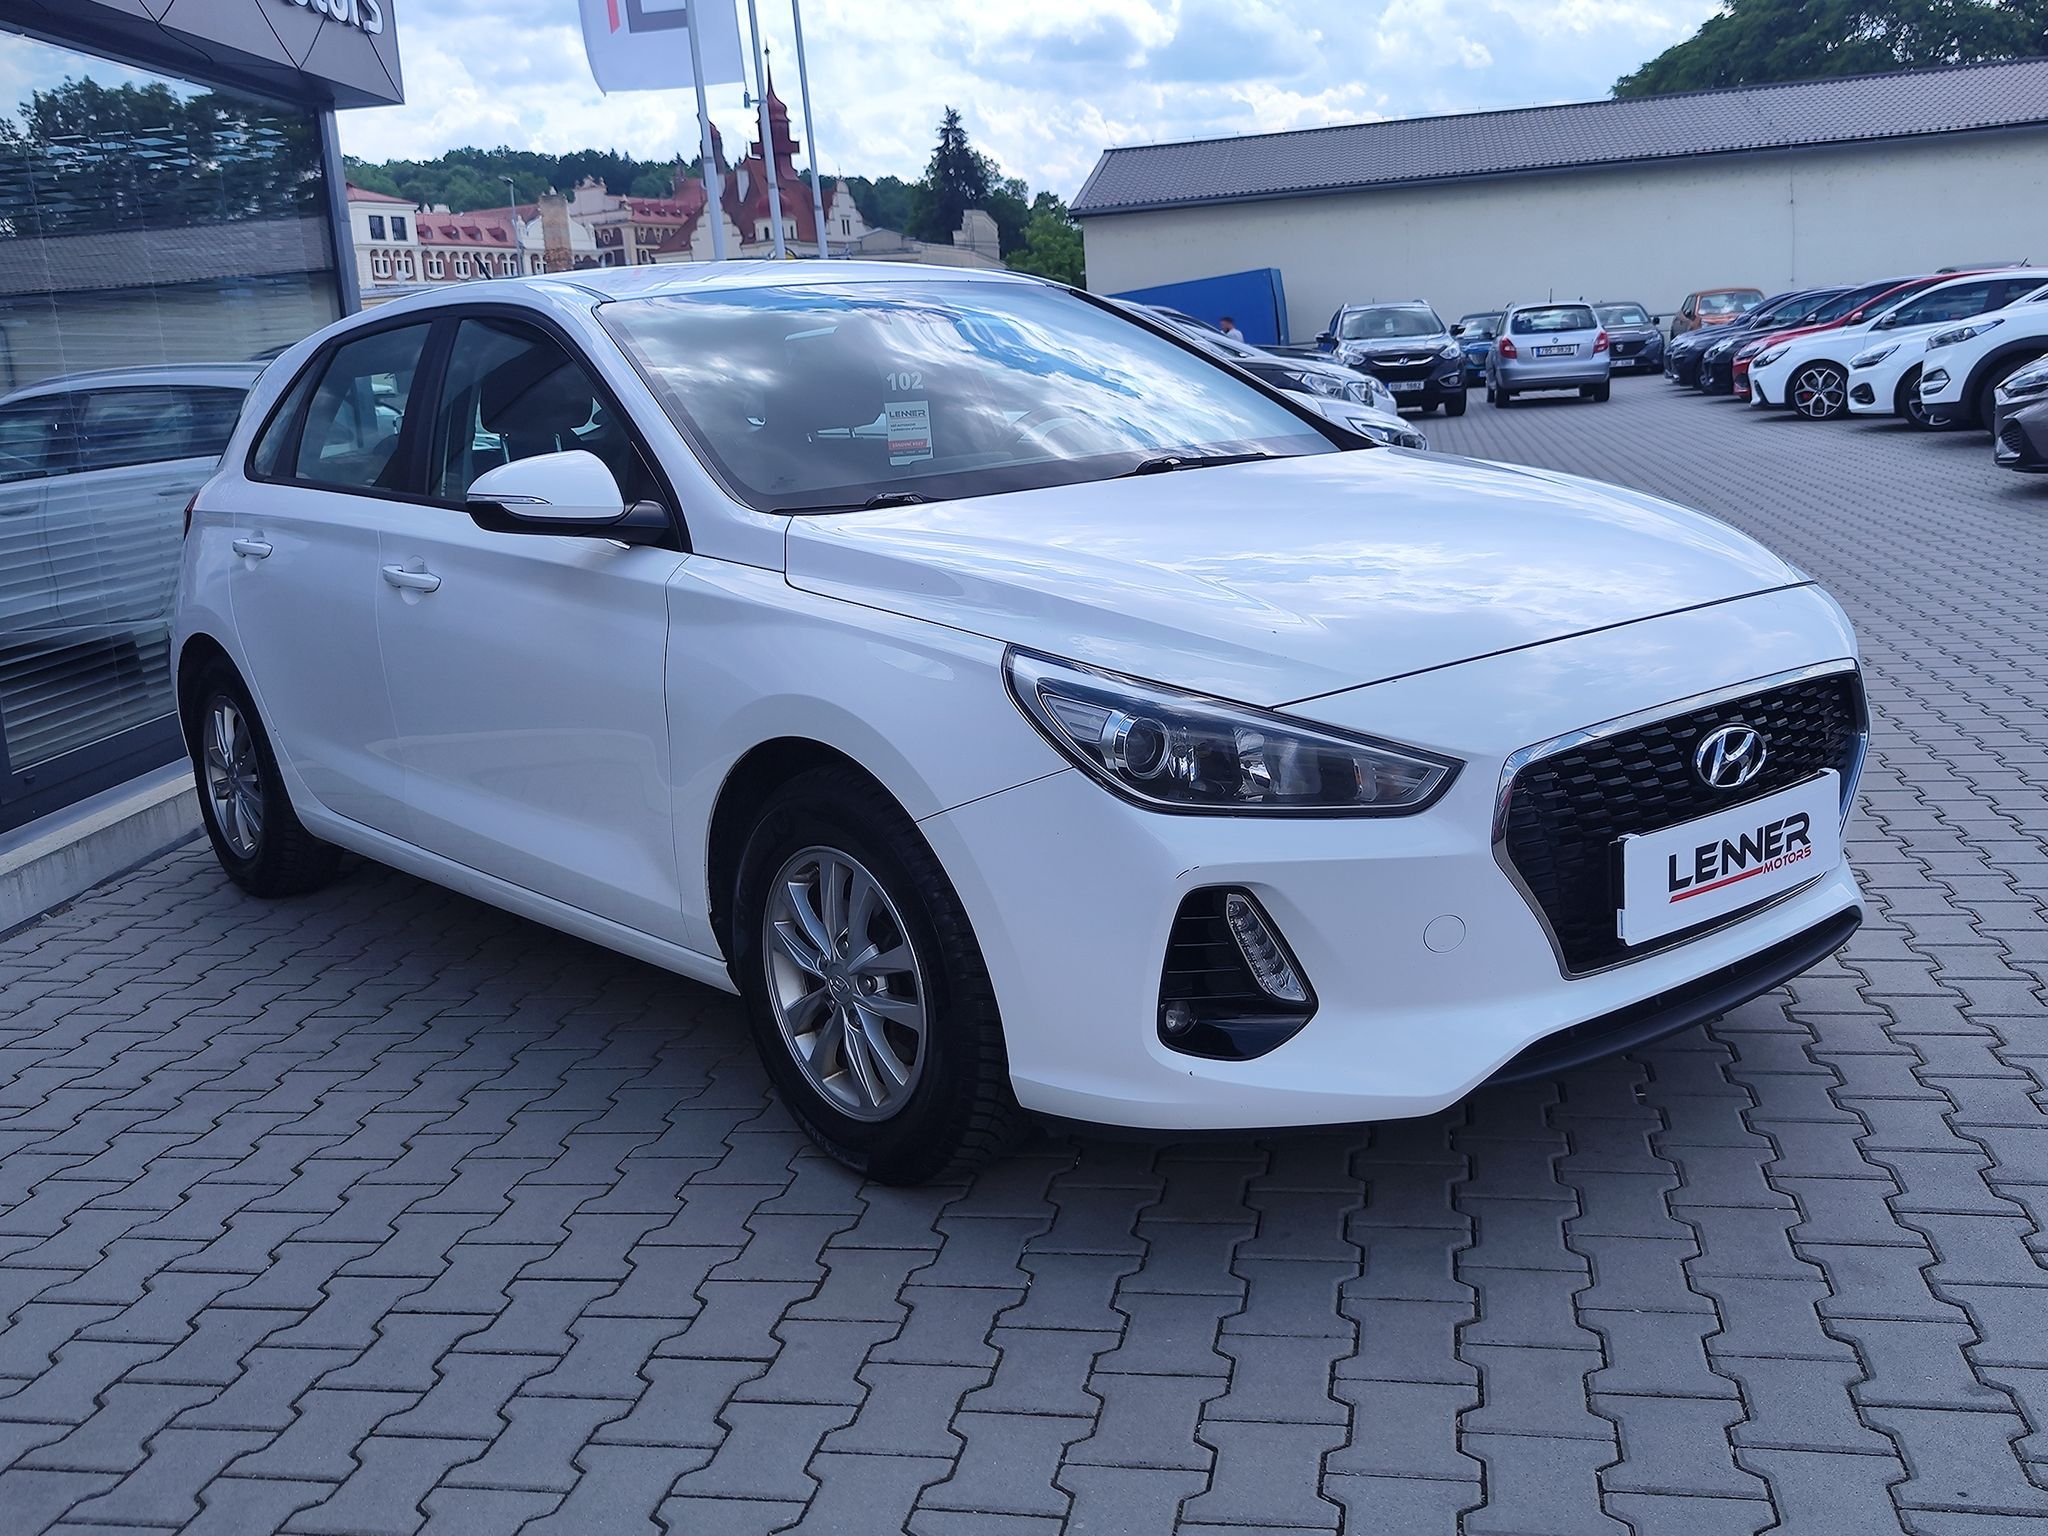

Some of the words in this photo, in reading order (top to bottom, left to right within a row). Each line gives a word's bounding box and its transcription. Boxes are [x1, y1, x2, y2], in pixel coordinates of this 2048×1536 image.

[886, 371, 924, 391] 102
[889, 409, 926, 418] LENNER
[1668, 811, 1812, 893] LENNER
[1762, 844, 1812, 875] MOTORS
